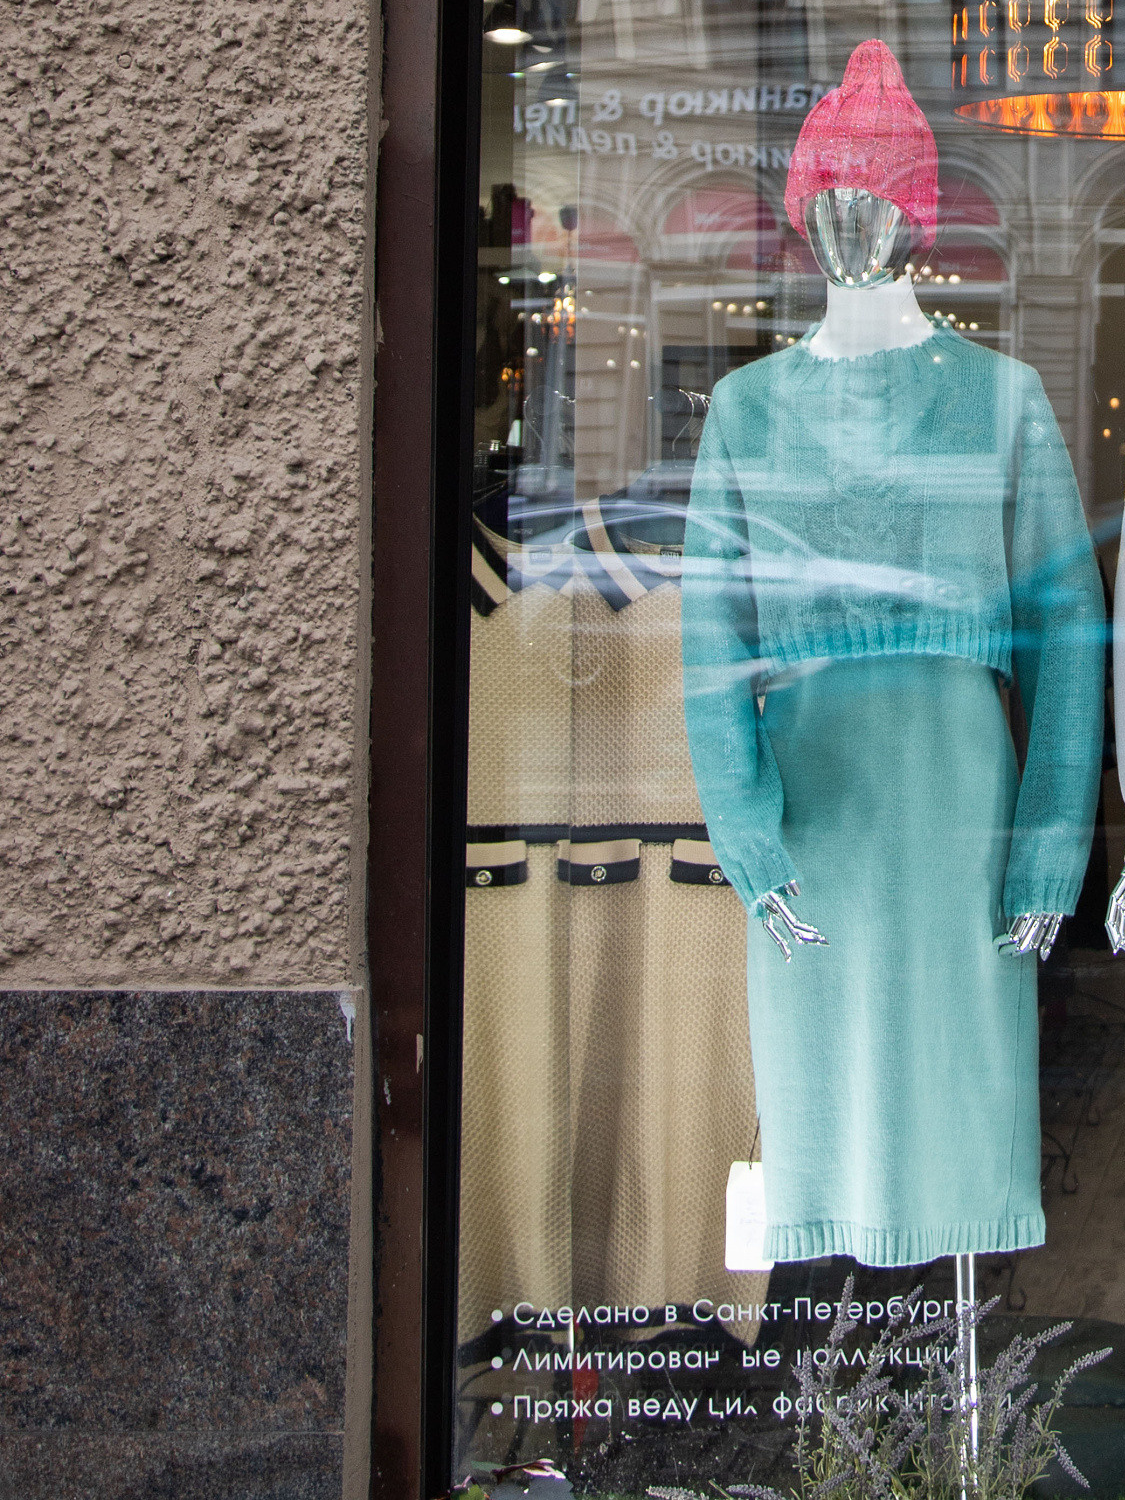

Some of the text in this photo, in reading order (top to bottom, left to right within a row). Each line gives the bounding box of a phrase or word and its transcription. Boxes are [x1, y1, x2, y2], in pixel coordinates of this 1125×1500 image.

[513, 1301, 650, 1329] Сделано
[664, 1304, 678, 1323] в
[513, 1395, 613, 1424] Пряжа
